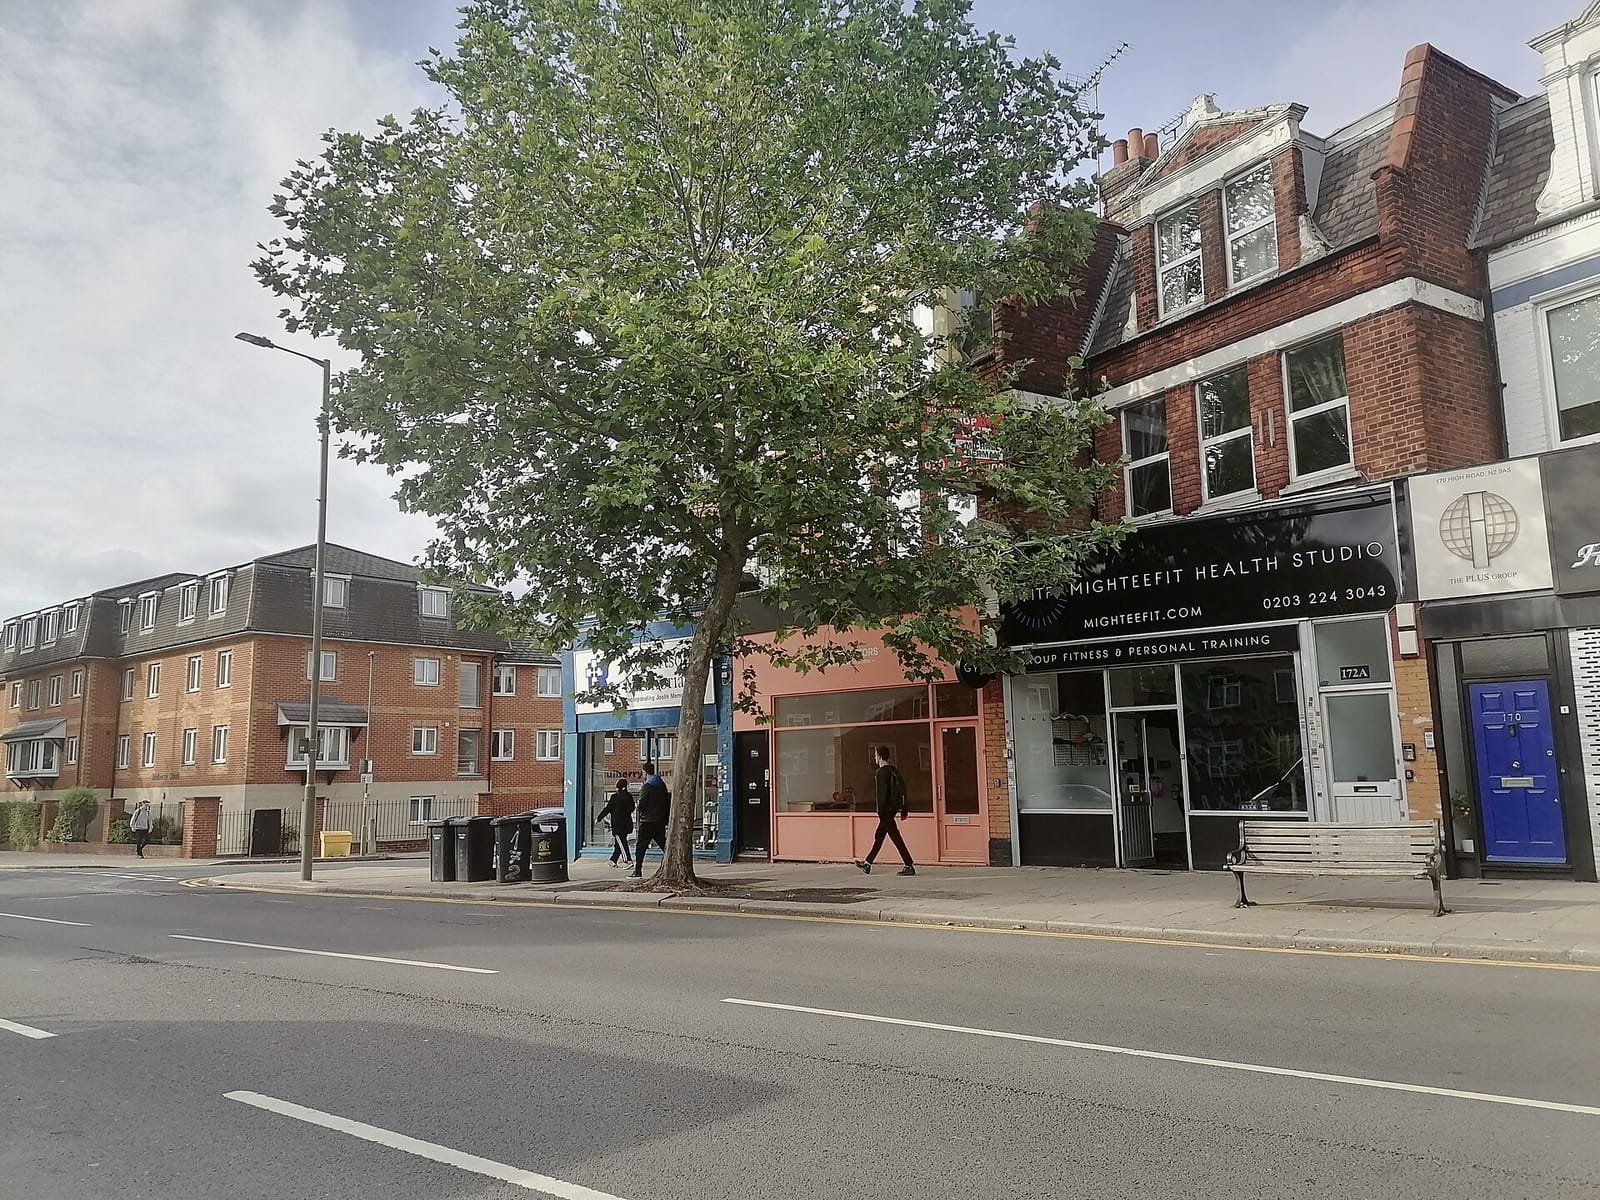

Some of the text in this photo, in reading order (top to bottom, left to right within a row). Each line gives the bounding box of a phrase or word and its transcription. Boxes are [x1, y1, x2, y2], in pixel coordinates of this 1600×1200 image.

[1070, 568, 1184, 596] MIGHTEEFIT
[1195, 556, 1279, 581] HEALTH
[1292, 541, 1384, 568] STUDIO
[1465, 573, 1489, 583] PLUS
[1491, 571, 1518, 580] GROUP
[1263, 584, 1387, 610] 0203 224 3043
[1083, 606, 1203, 629] MIGHTEEFIT.COM
[1026, 634, 1271, 666] OUP FITNESS & PERSONAL TRAINING
[1341, 666, 1369, 680] 172A
[1503, 713, 1521, 722] 170
